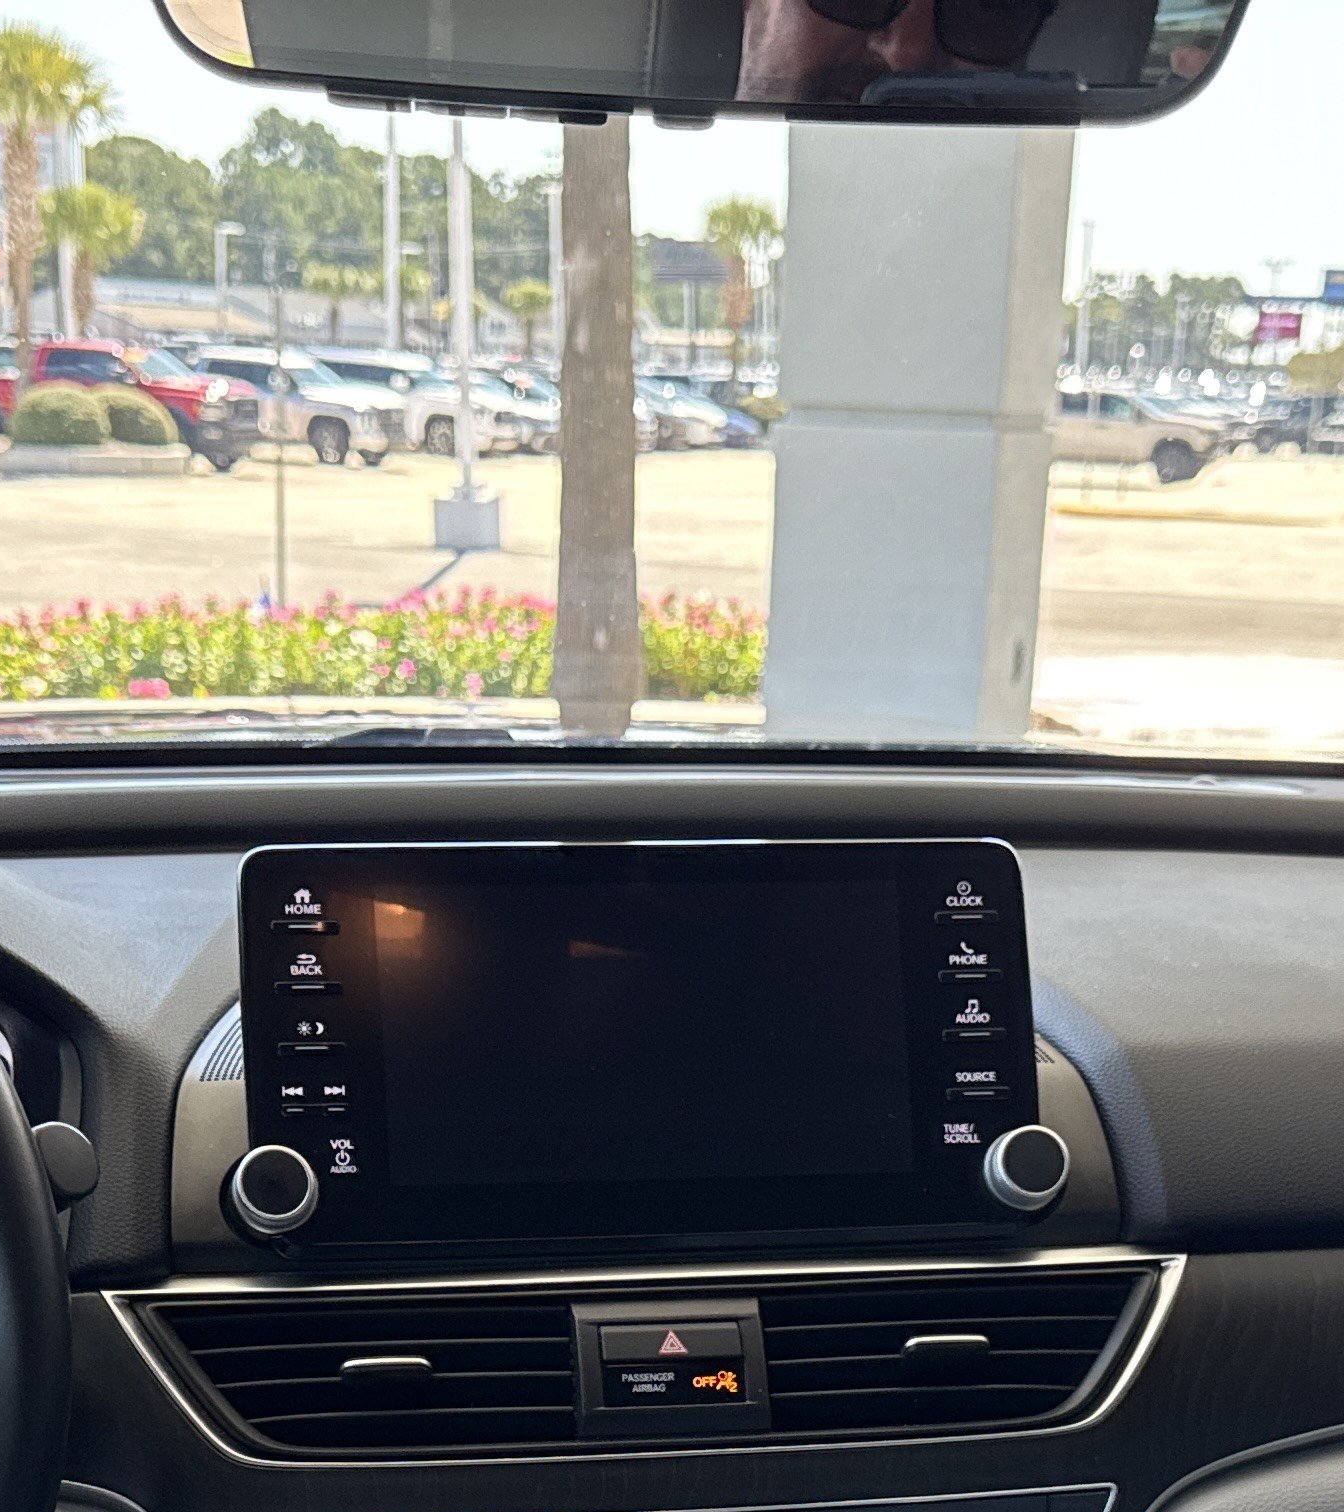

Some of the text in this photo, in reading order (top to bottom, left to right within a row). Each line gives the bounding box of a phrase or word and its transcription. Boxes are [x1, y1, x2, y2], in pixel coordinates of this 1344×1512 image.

[945, 895, 984, 907] CLOCK
[284, 903, 322, 915] HOME
[948, 954, 988, 966] PHONE
[289, 964, 323, 976] BACK
[955, 1012, 992, 1024] AUDIO
[955, 1071, 997, 1083] SOURCE
[329, 1138, 355, 1150] VOL
[943, 1133, 981, 1144] SCROLL
[621, 1371, 676, 1383] PASSENGER
[692, 1375, 718, 1388] OFF
[631, 1382, 667, 1393] AIRBAG
